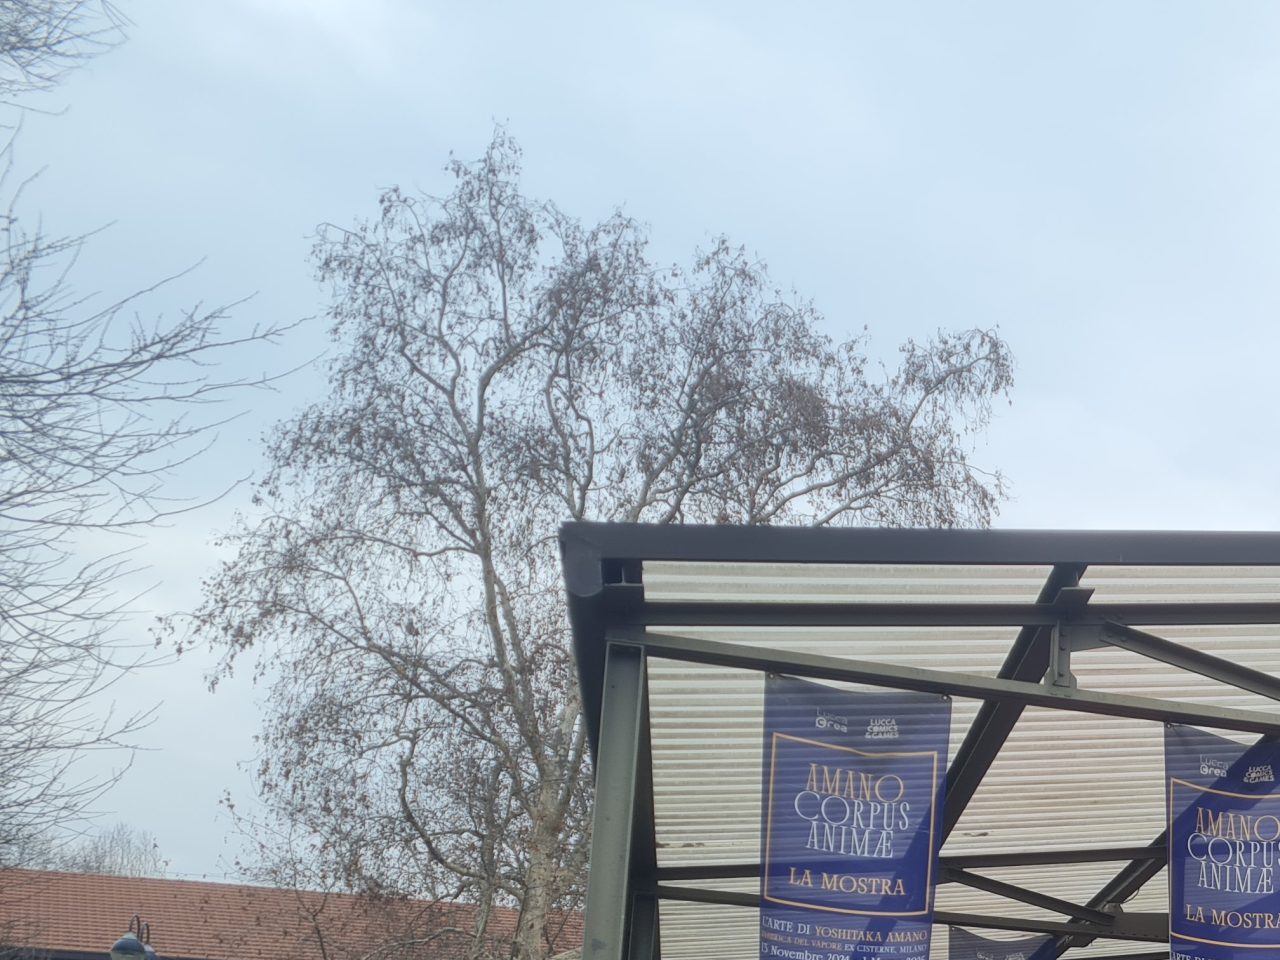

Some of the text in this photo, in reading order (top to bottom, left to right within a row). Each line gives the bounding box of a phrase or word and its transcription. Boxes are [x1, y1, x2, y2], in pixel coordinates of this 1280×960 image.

[870, 718, 896, 726] LUCCA
[1248, 765, 1272, 773] LUCCA
[806, 763, 904, 803] AMANO
[794, 790, 910, 830] CORPUS
[805, 820, 893, 858] ANIMÆ
[788, 867, 906, 895] LA MOSTRA
[1197, 860, 1274, 894] ANIMÆ
[1186, 904, 1205, 923] LA
[793, 936, 810, 946] DEL
[811, 939, 842, 950] VAPORE
[844, 943, 856, 951] EX
[900, 943, 927, 953] MILANO
[797, 923, 810, 934] DI
[815, 926, 881, 942] YOSHITAKA
[886, 930, 928, 943] AMANO
